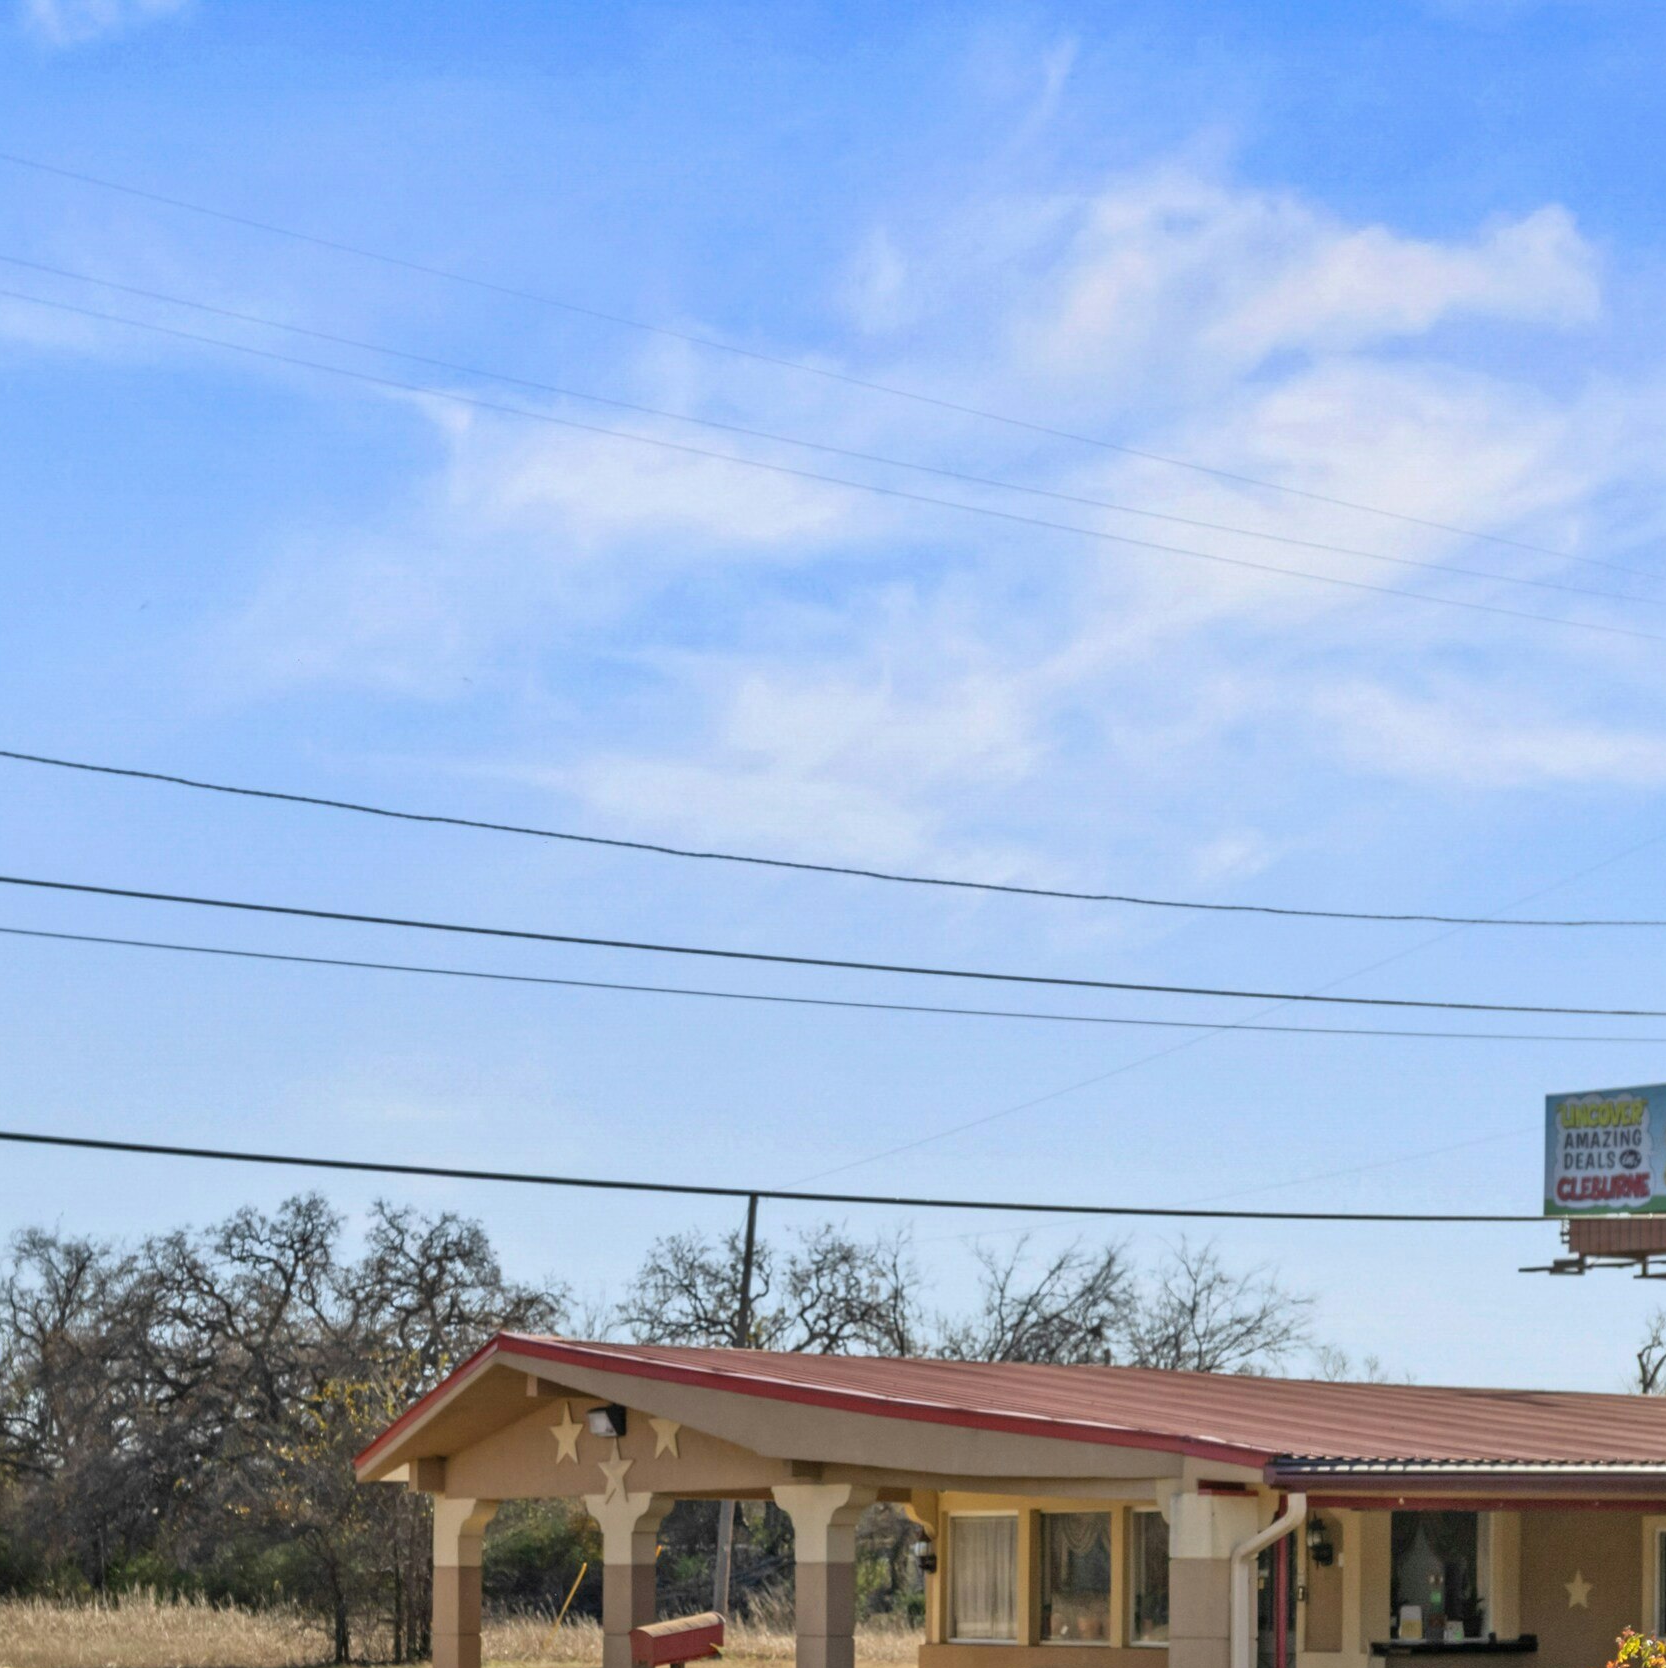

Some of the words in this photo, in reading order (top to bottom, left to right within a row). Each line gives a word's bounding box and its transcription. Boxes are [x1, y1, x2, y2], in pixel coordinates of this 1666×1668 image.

[1564, 1128, 1642, 1150] AMAZING
[1564, 1150, 1616, 1170] DEALS
[1557, 1172, 1650, 1202] CLEBURNE
